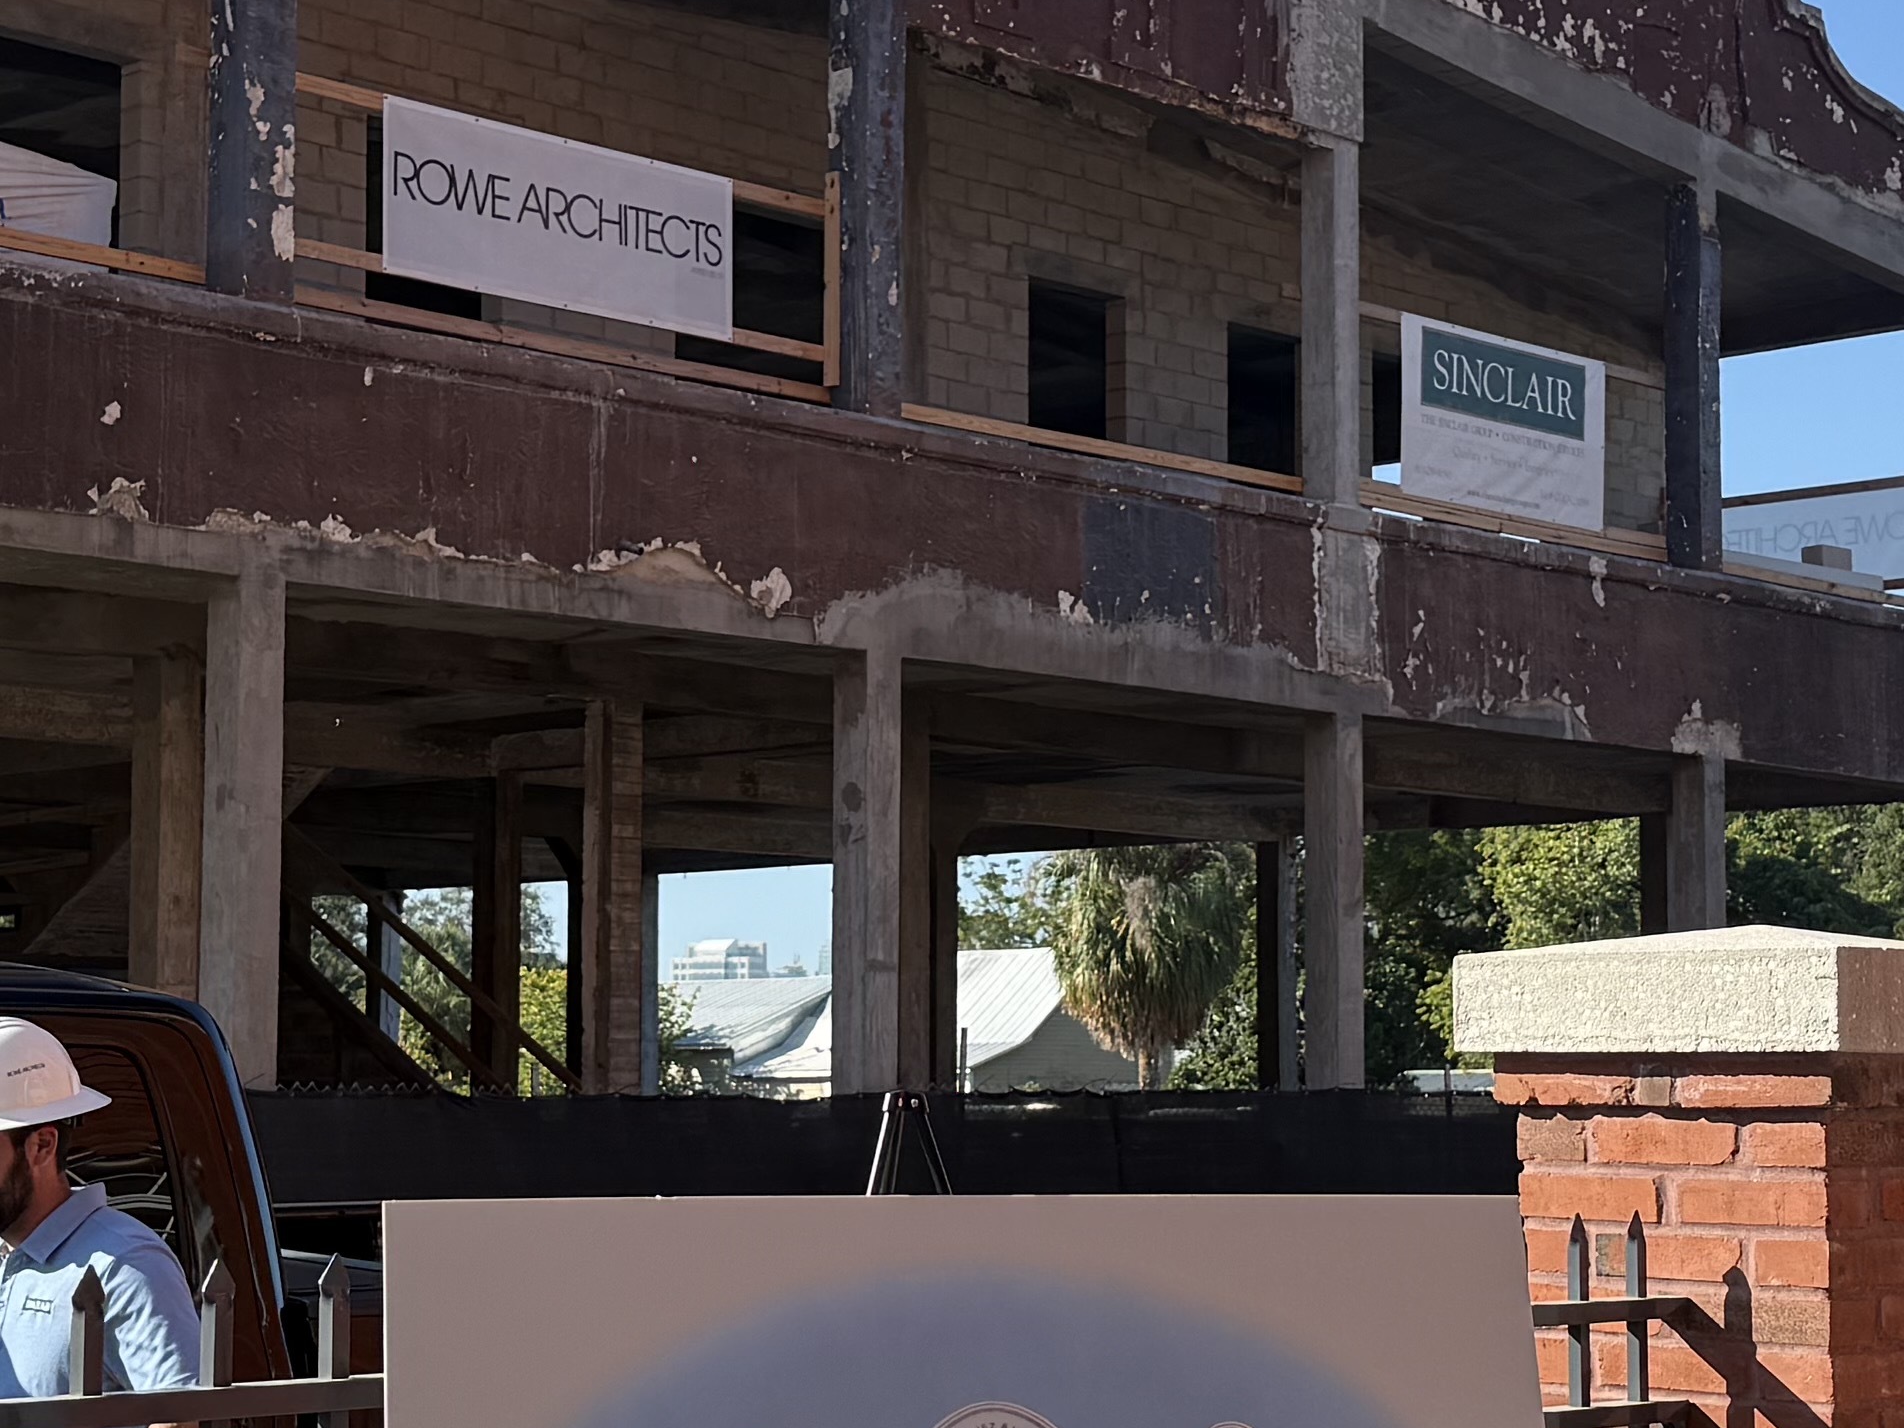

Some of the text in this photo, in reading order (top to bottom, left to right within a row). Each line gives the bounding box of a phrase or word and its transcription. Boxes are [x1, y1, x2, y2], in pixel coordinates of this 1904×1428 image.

[393, 150, 723, 267] ROWE ARCHITECTS
[1432, 348, 1577, 421] SINCLAIR
